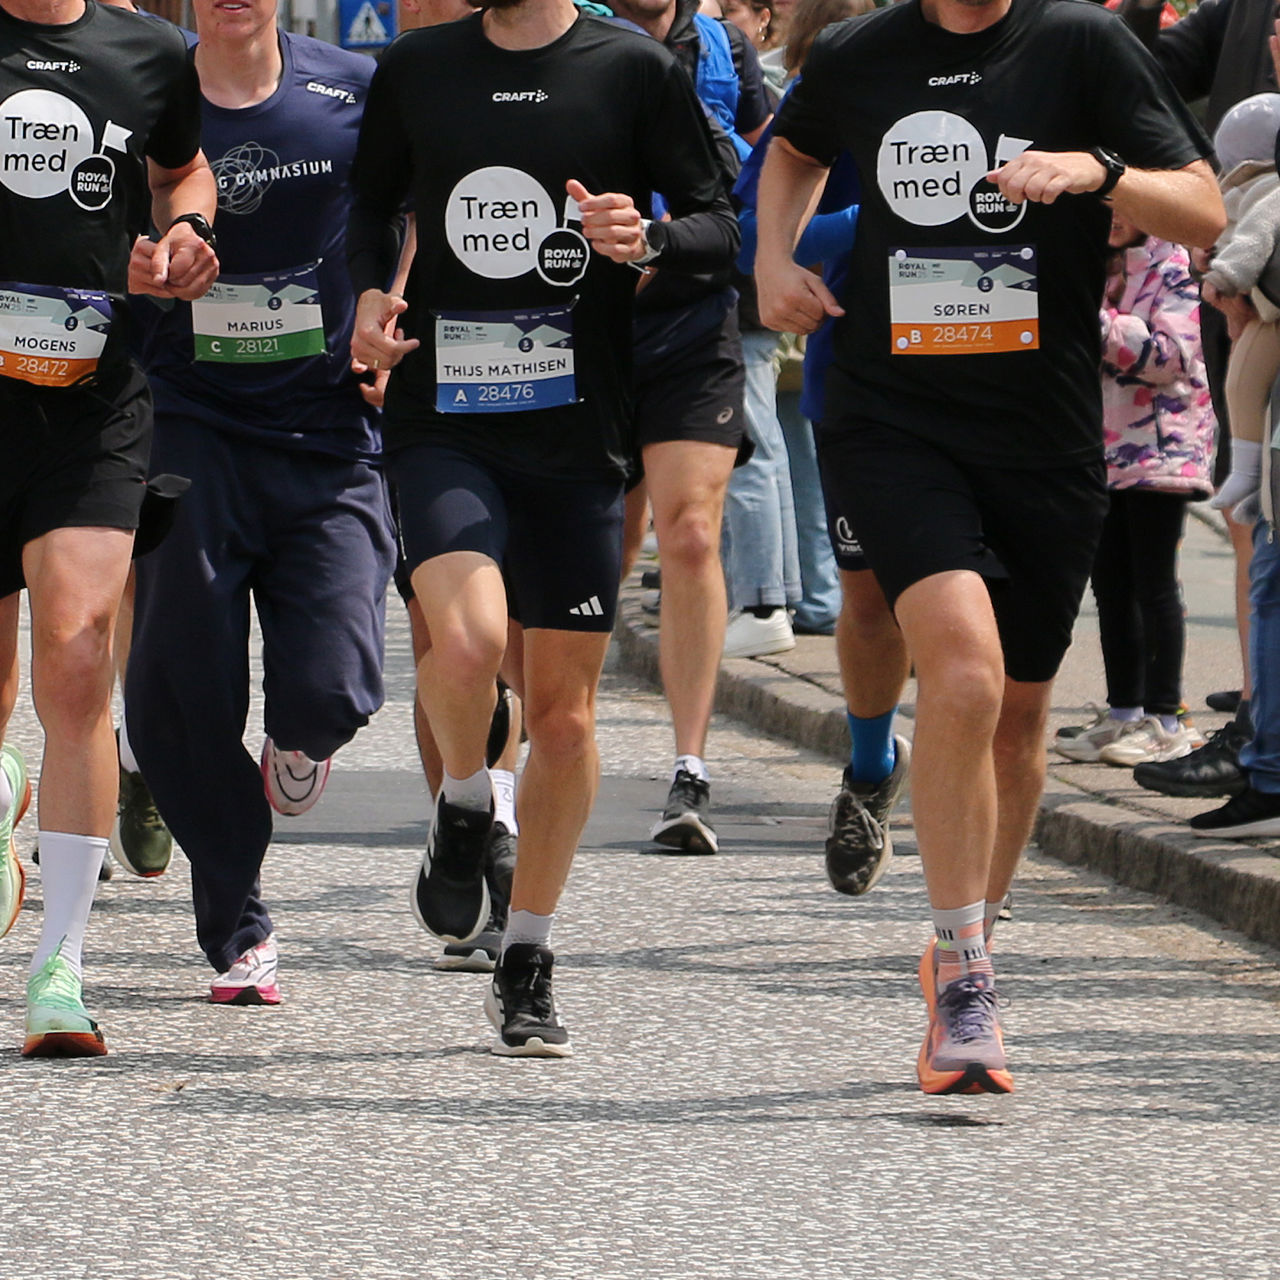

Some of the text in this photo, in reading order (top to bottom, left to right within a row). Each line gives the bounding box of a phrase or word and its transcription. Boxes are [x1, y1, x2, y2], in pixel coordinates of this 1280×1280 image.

[26, 60, 69, 71] CRAFT
[928, 73, 971, 87] CRAFT
[306, 82, 348, 100] CRAFT
[492, 91, 536, 102] CRAFT
[5, 116, 79, 142] Træn
[4, 149, 67, 172] med
[890, 141, 969, 165] Træn
[77, 172, 109, 183] ROYA
[236, 160, 333, 186] GYMNASIUM
[77, 183, 100, 192] RUN
[893, 170, 961, 199] med
[460, 196, 538, 220] Træn
[976, 203, 1005, 214] RUN
[462, 226, 530, 252] med
[544, 249, 584, 259] ROYAL
[544, 259, 571, 269] RUN
[933, 303, 990, 316] SØREN
[227, 319, 284, 332] MARIUS
[910, 326, 993, 344] B 28474
[14, 336, 77, 353] MOGENS
[211, 338, 278, 354] C 28121
[16, 357, 69, 376] 28472
[443, 358, 567, 377] THIJS MATHISEN
[455, 384, 534, 403] A 28476
